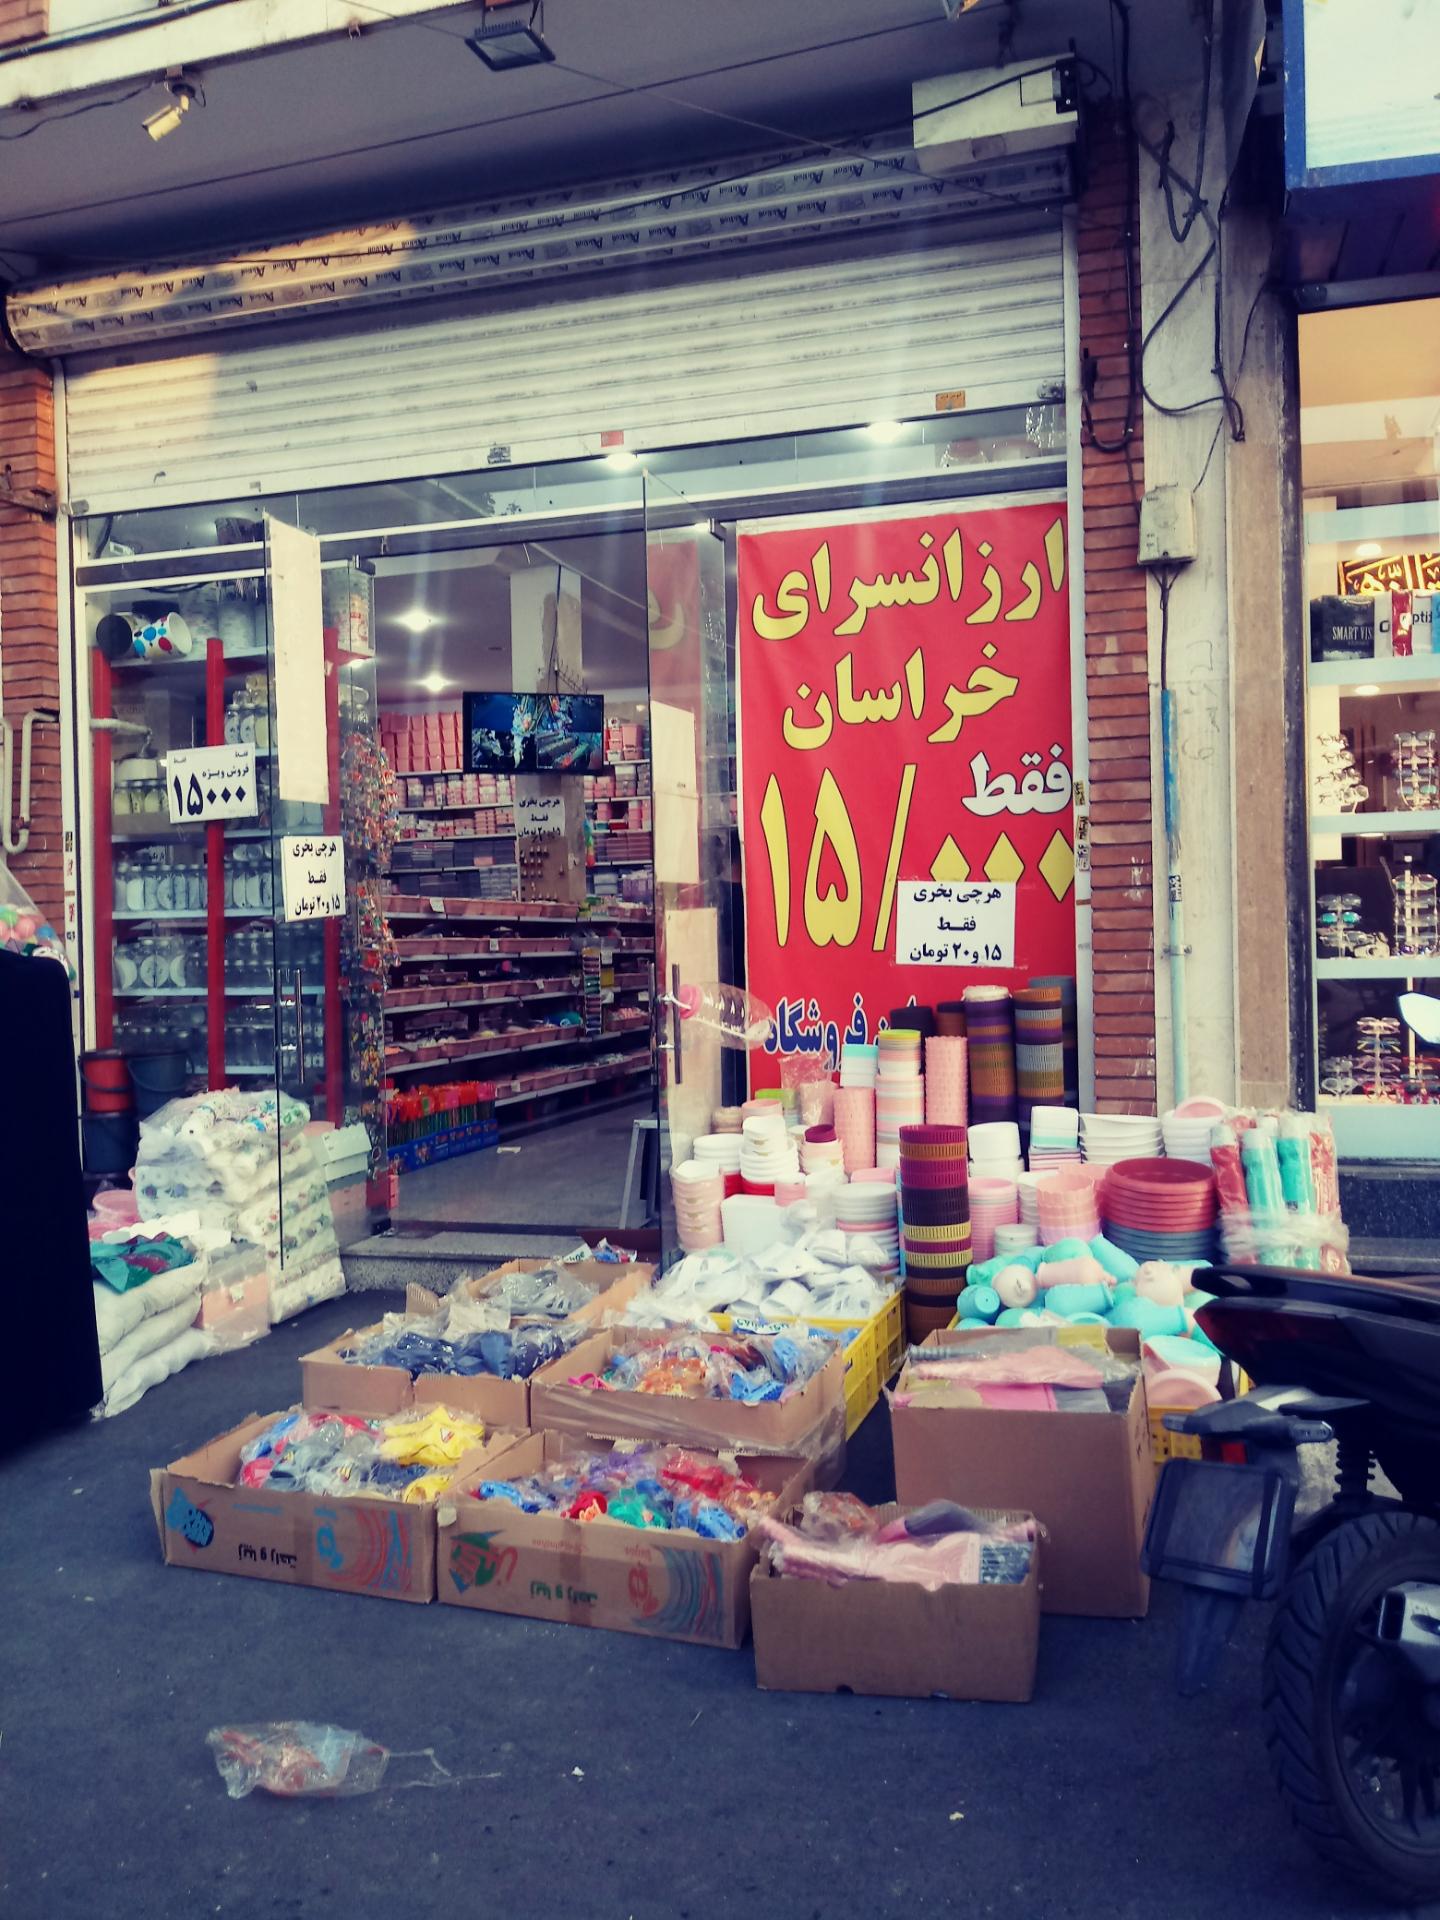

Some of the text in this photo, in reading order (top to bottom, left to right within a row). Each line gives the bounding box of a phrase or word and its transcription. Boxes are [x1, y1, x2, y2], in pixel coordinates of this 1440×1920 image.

[752, 517, 1065, 641] ارزانسرای
[1332, 626, 1359, 641] SMART
[782, 642, 1020, 751] خراسان
[227, 764, 249, 778] فروش
[961, 743, 1074, 817] فقط
[173, 772, 246, 816] ۱۵۰۰۰
[293, 839, 314, 857] بخری
[307, 869, 327, 884] فقط
[331, 893, 341, 910] ۱۵
[913, 883, 953, 903] بخری
[294, 896, 315, 916] تومان
[937, 916, 977, 931] فقط
[909, 942, 949, 962] تومان
[984, 943, 1002, 961] ۱۵
